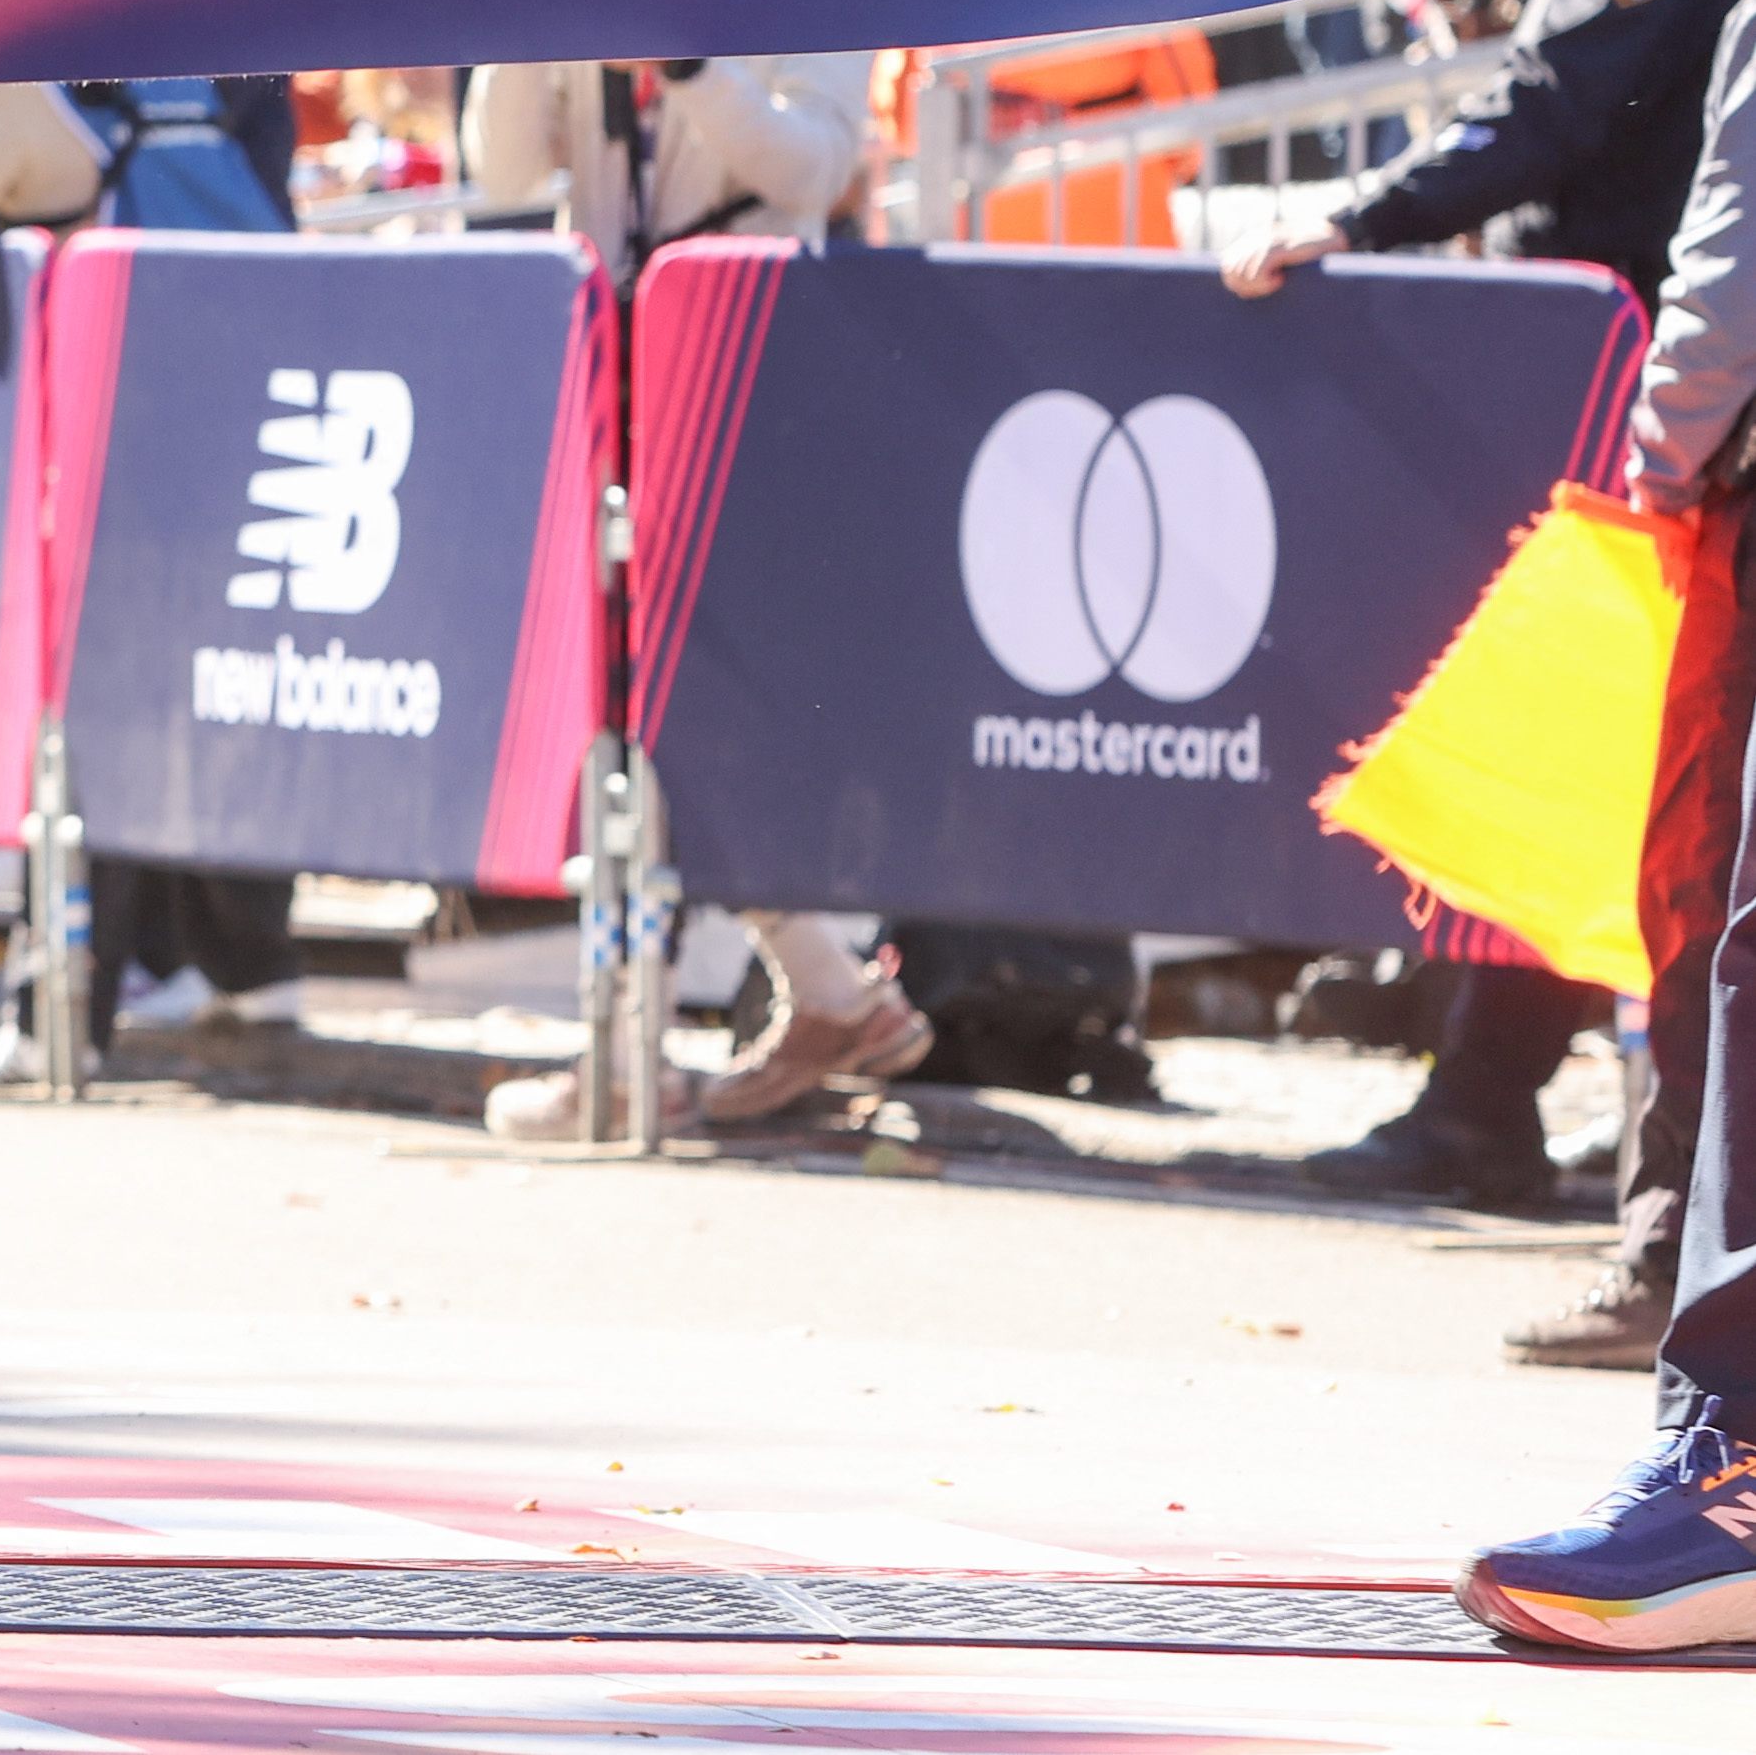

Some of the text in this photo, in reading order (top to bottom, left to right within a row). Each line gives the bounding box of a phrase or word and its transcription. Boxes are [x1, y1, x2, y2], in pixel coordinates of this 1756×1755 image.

[193, 633, 442, 738] new balance
[972, 708, 1261, 783] mastercard
